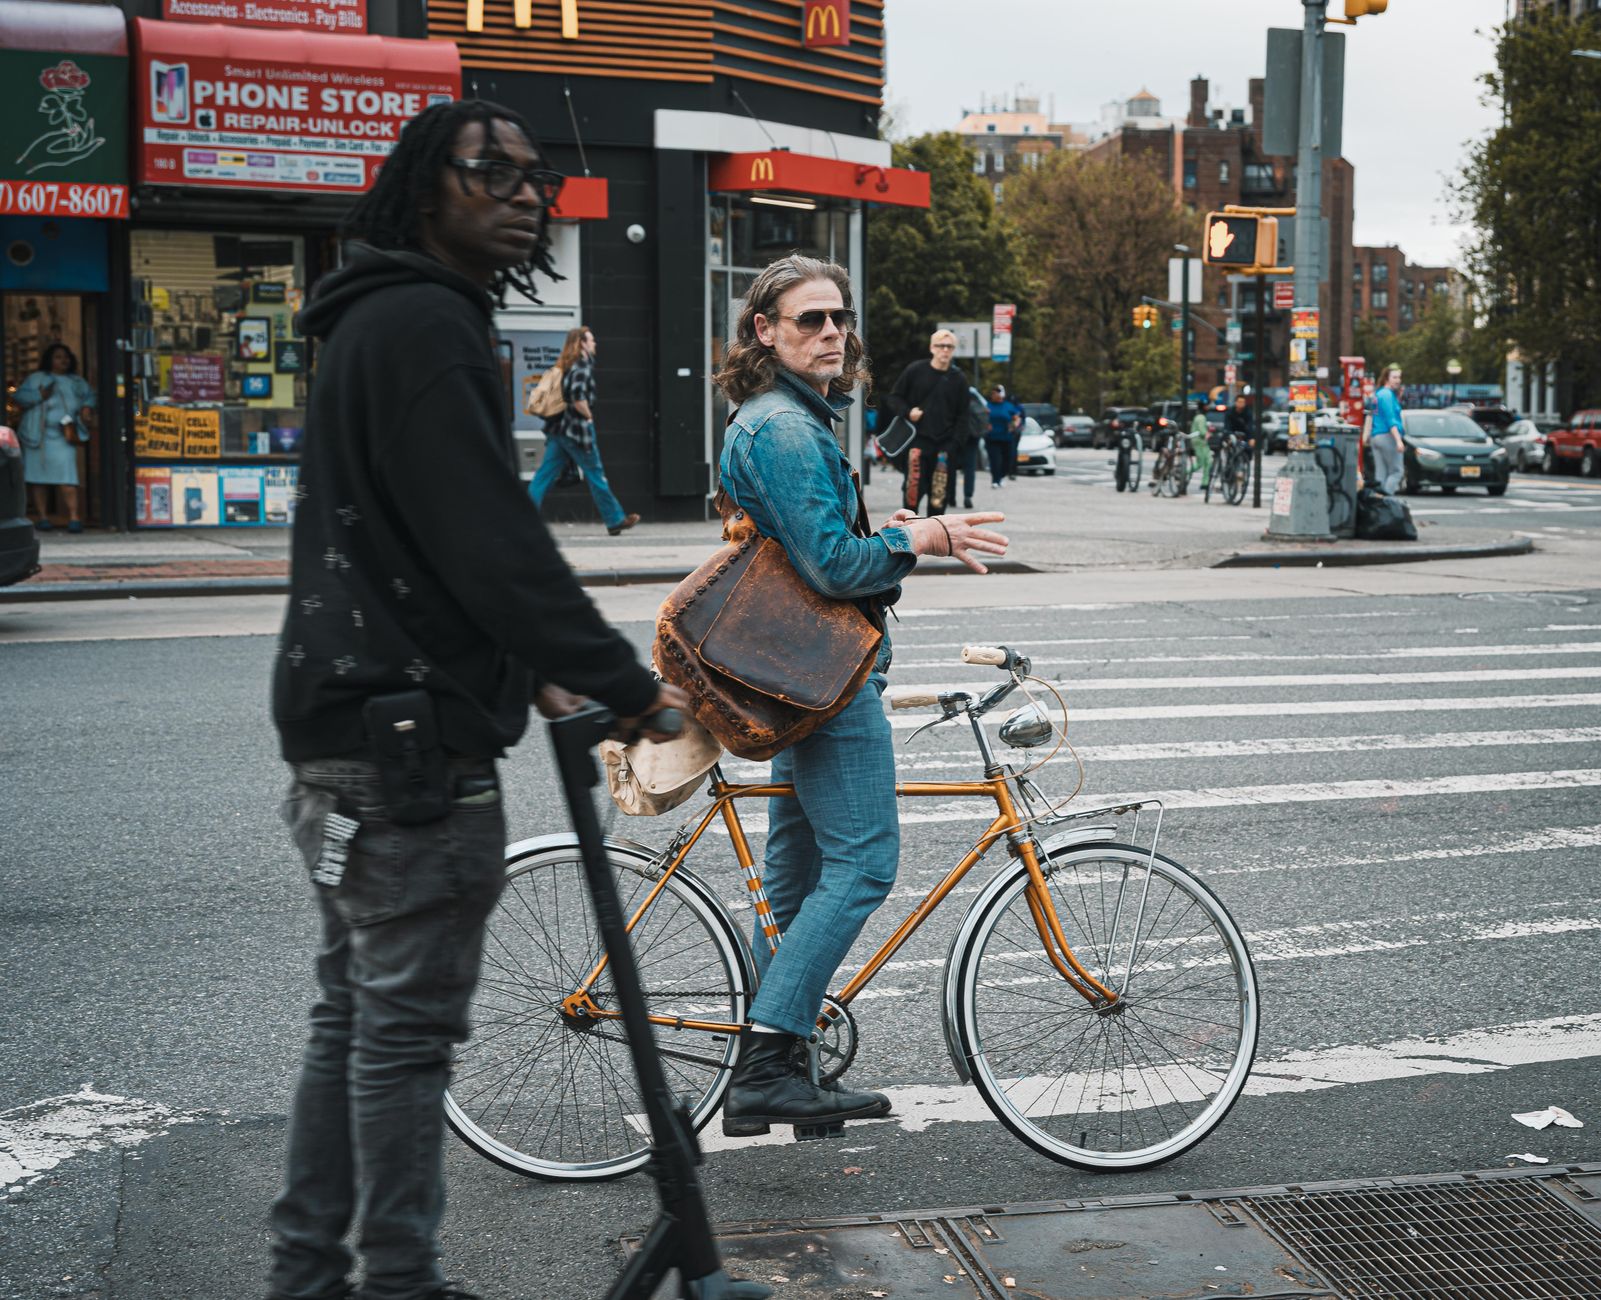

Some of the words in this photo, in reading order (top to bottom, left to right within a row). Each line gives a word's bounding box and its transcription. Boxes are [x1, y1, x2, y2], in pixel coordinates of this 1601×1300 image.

[169, 0, 239, 19] Accessories
[245, 3, 309, 24] Electronics
[315, 9, 337, 30] Pay
[338, 10, 363, 29] Bills
[224, 64, 262, 79] Smart
[266, 68, 328, 83] Unlimited
[332, 72, 385, 87] Wireless
[194, 80, 310, 111] PHONE
[321, 88, 421, 117] STORE
[224, 113, 394, 137] REPAIR-UNLOCK
[17, 182, 125, 215] 607-8607
